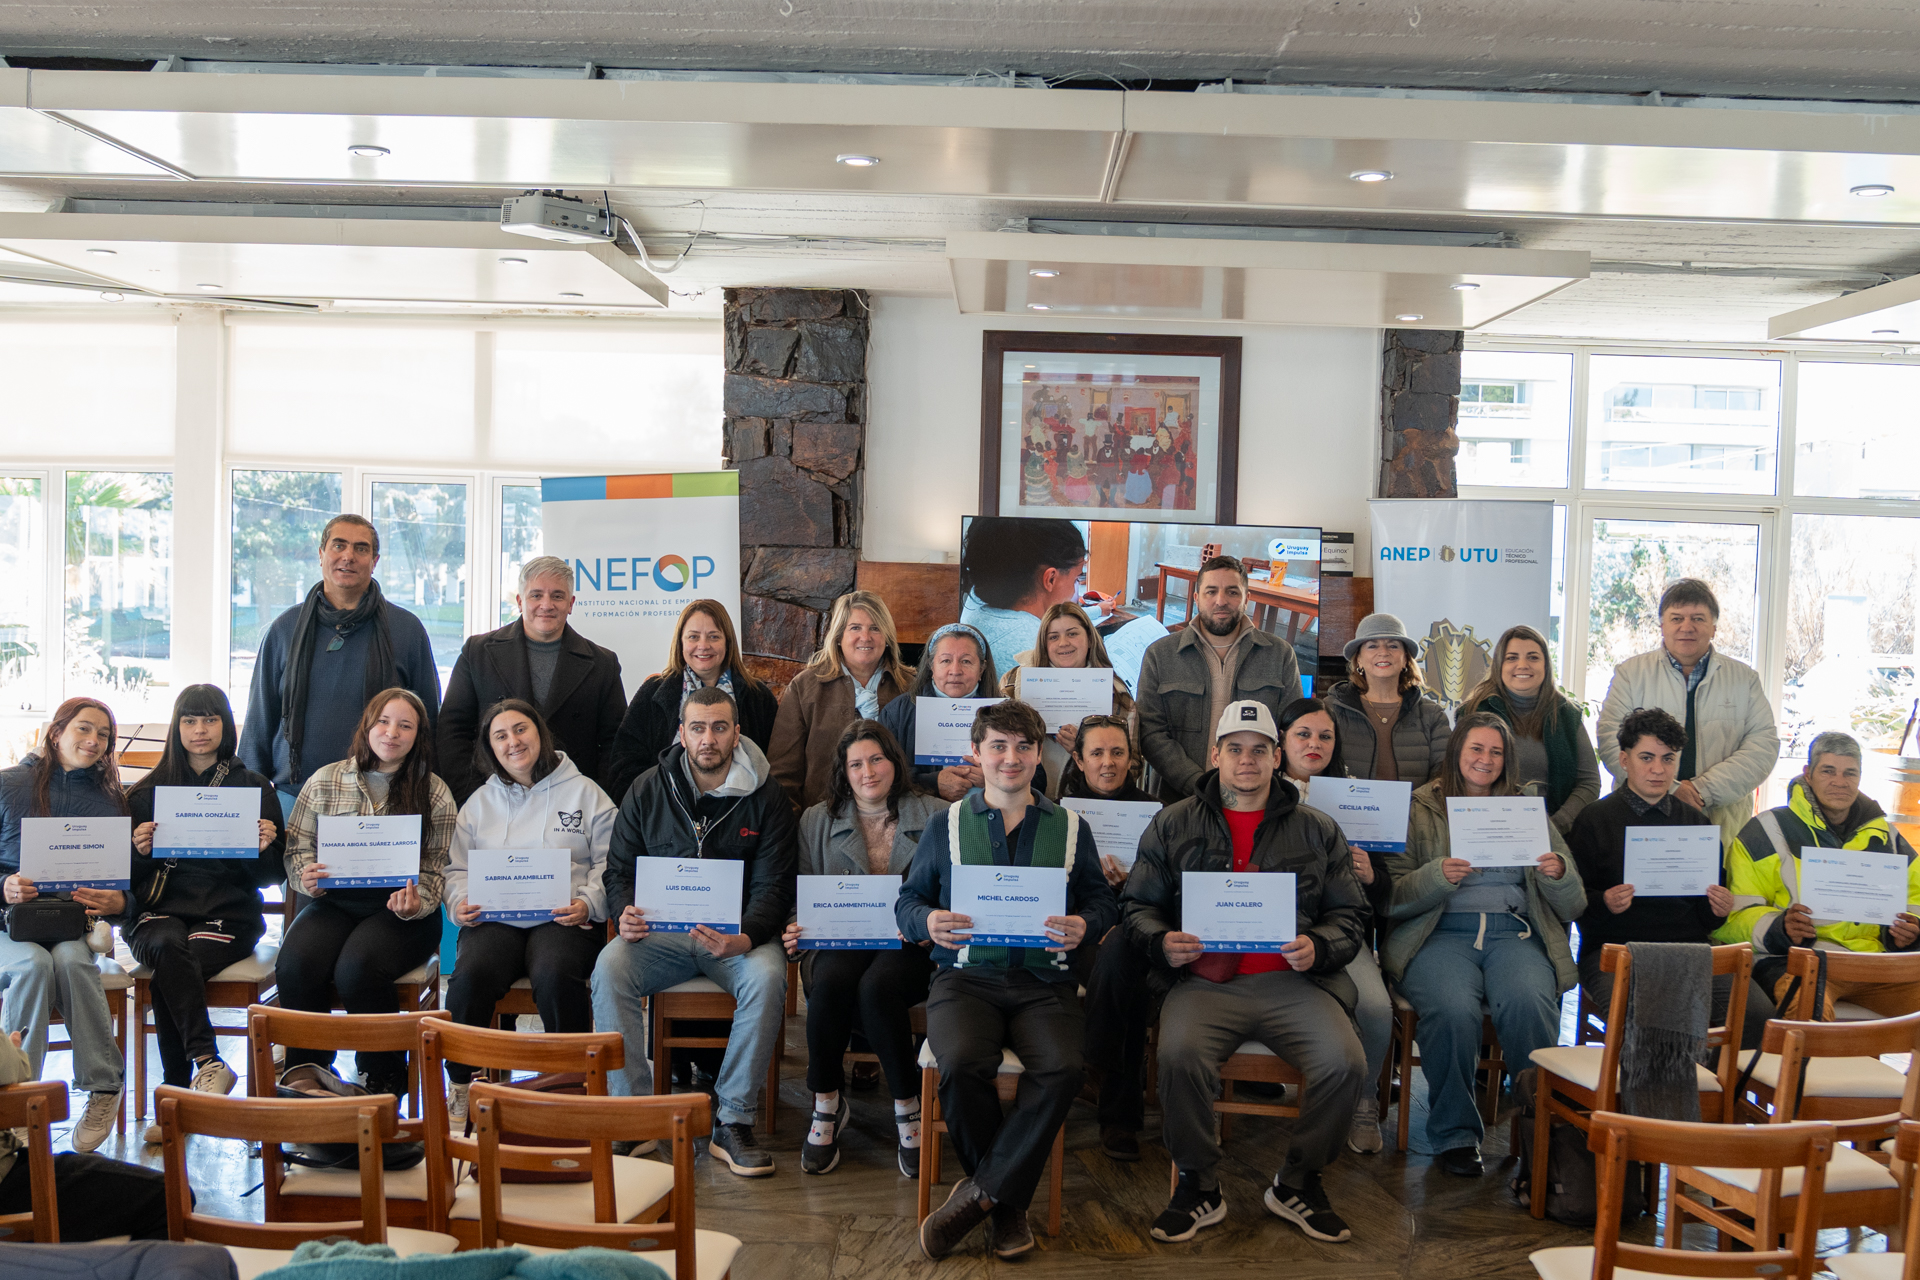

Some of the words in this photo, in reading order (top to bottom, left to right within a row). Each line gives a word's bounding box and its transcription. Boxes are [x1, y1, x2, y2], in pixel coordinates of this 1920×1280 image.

[1380, 546, 1431, 561] ANEP
[1459, 547, 1498, 563] UTU
[565, 554, 715, 592] NEFOP
[592, 610, 640, 618] FORMACIÓN
